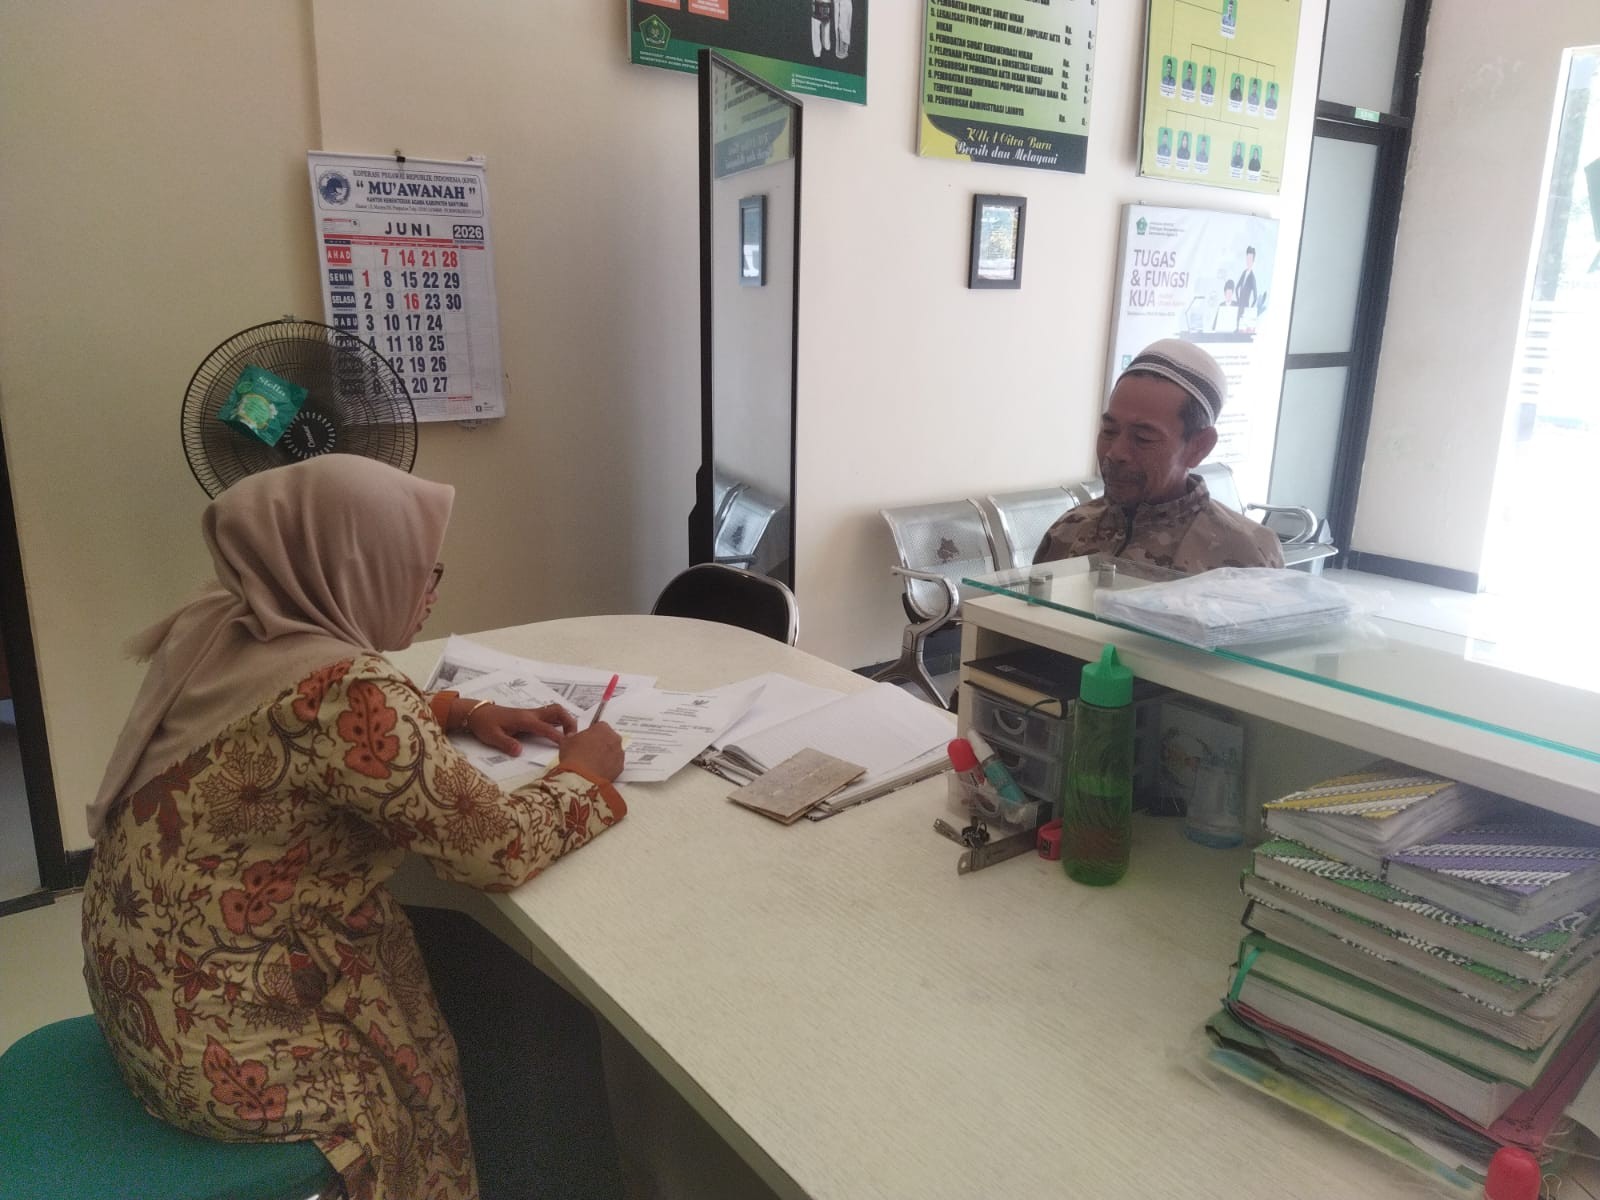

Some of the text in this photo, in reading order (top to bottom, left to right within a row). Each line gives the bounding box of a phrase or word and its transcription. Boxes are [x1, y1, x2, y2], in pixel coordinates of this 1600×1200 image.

[956, 141, 1059, 165] Bersih dan Melayani
[385, 221, 482, 239] JUNI 2026
[327, 248, 458, 268] AHAD 7 14 21 28
[1133, 249, 1177, 268] TUGAS
[329, 269, 460, 289] SENIN 1 8 15 22 29
[1130, 269, 1190, 288] & FUNGSI
[331, 292, 462, 310] SELASA 2 9 16 23 30
[1129, 289, 1156, 307] KUA
[366, 314, 375, 331] 3
[383, 314, 400, 331] 10
[405, 314, 421, 331] 17
[426, 314, 443, 331] 24
[386, 335, 402, 352] 11
[407, 335, 424, 352] 18
[428, 335, 445, 352] 25
[388, 356, 405, 373] 12
[409, 356, 426, 373] 19
[430, 356, 447, 372] 26
[411, 377, 428, 394] 20
[432, 376, 448, 393] 27
